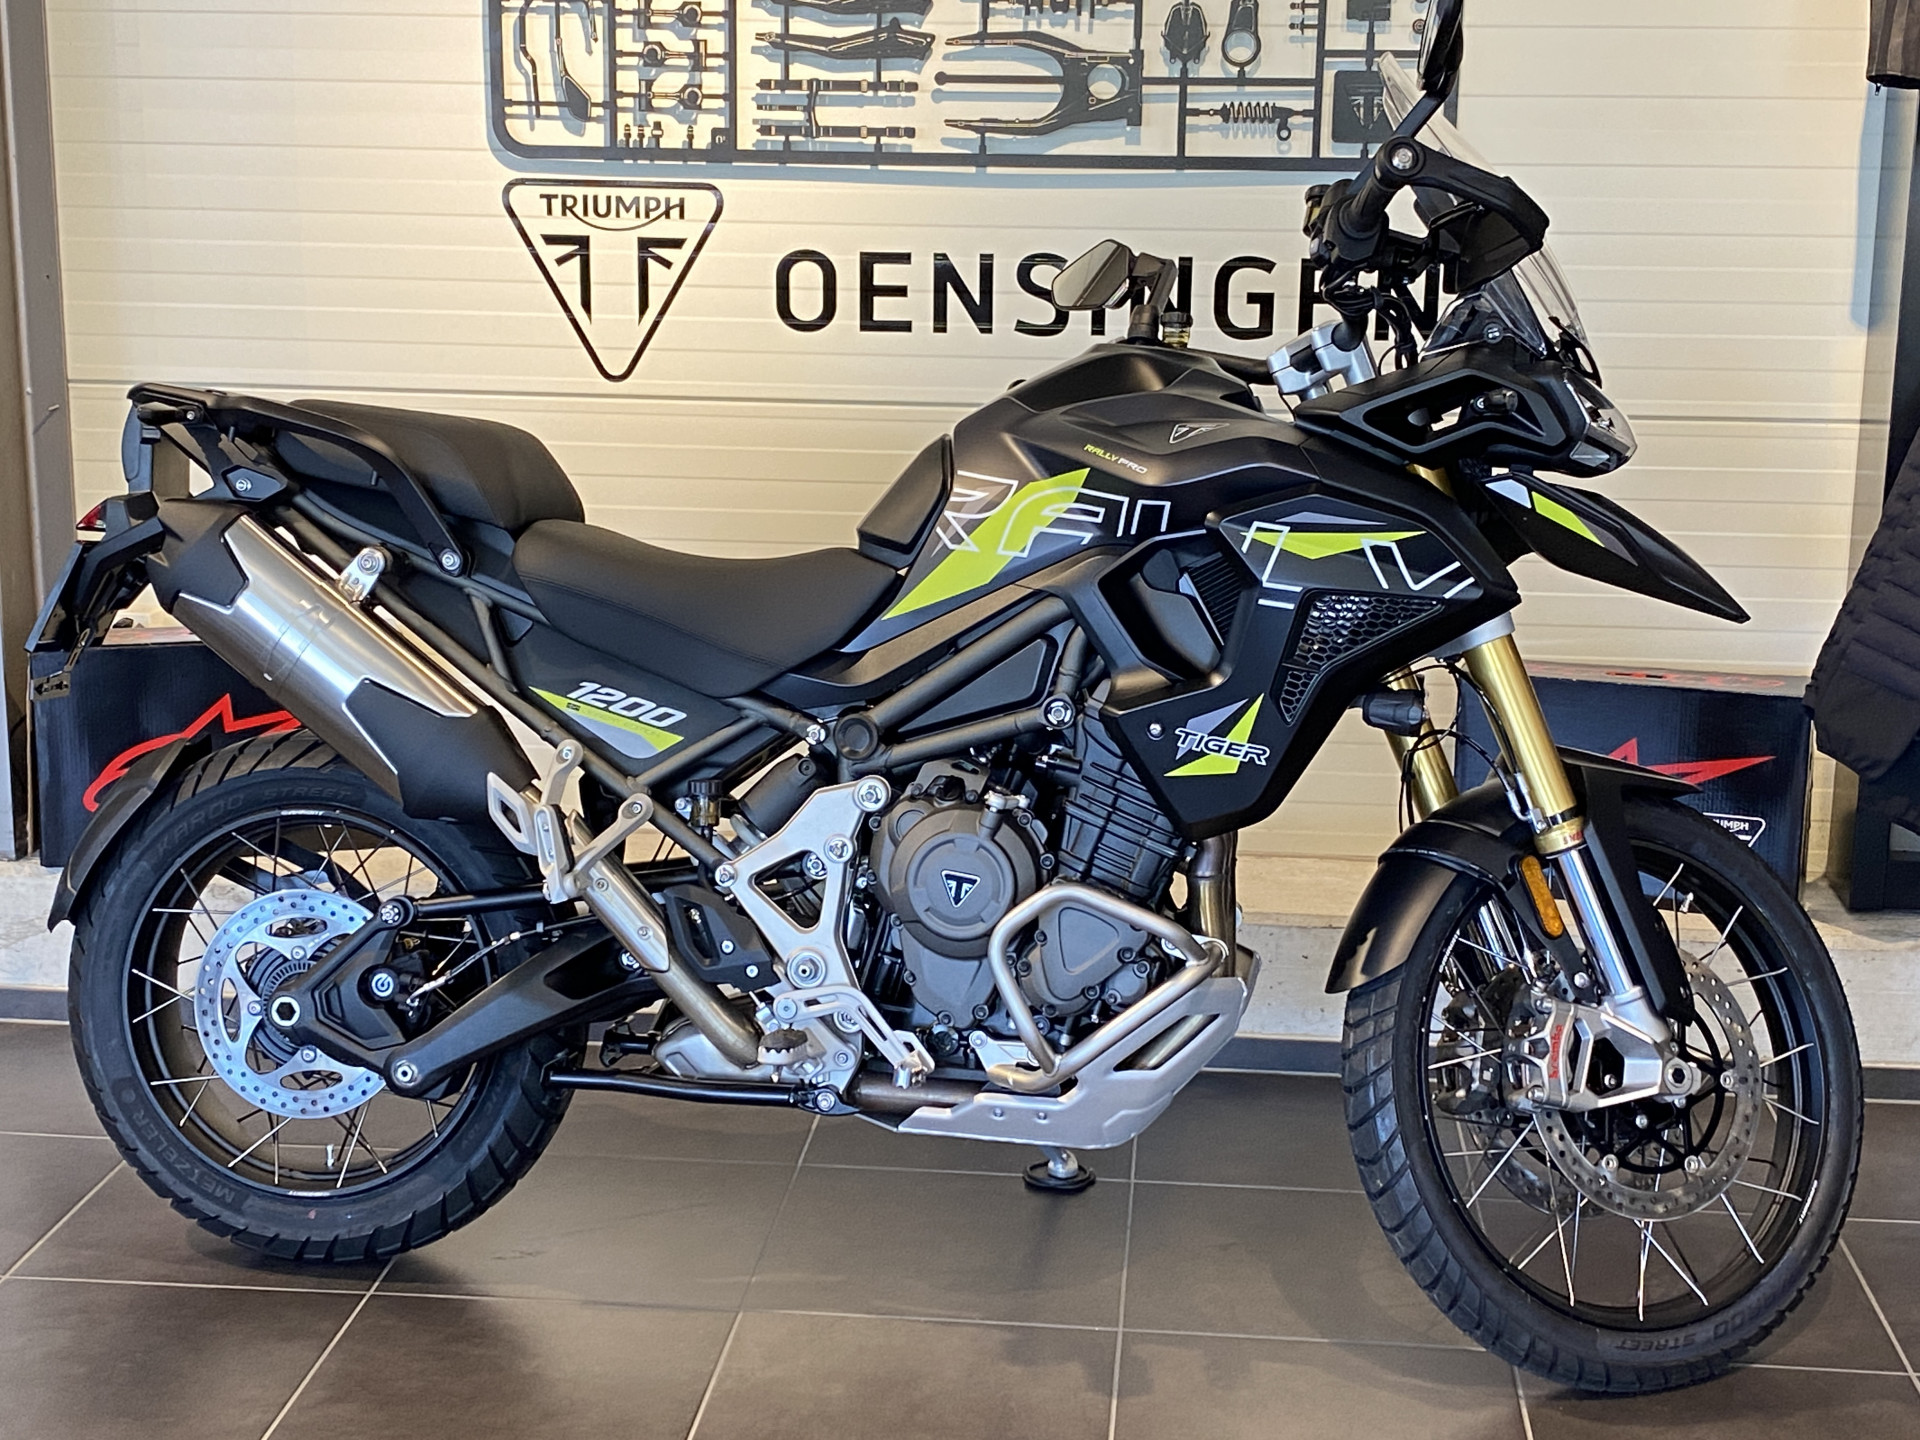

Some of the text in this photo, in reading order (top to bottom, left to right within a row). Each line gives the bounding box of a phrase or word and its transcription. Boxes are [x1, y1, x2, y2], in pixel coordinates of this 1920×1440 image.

[539, 194, 686, 225] TRIUMPH
[1083, 443, 1149, 475] RALLY PRO
[566, 681, 688, 728] 1200
[1174, 727, 1271, 767] TIGER
[131, 1108, 237, 1204] METZELER
[1615, 1332, 1698, 1352] STREET
